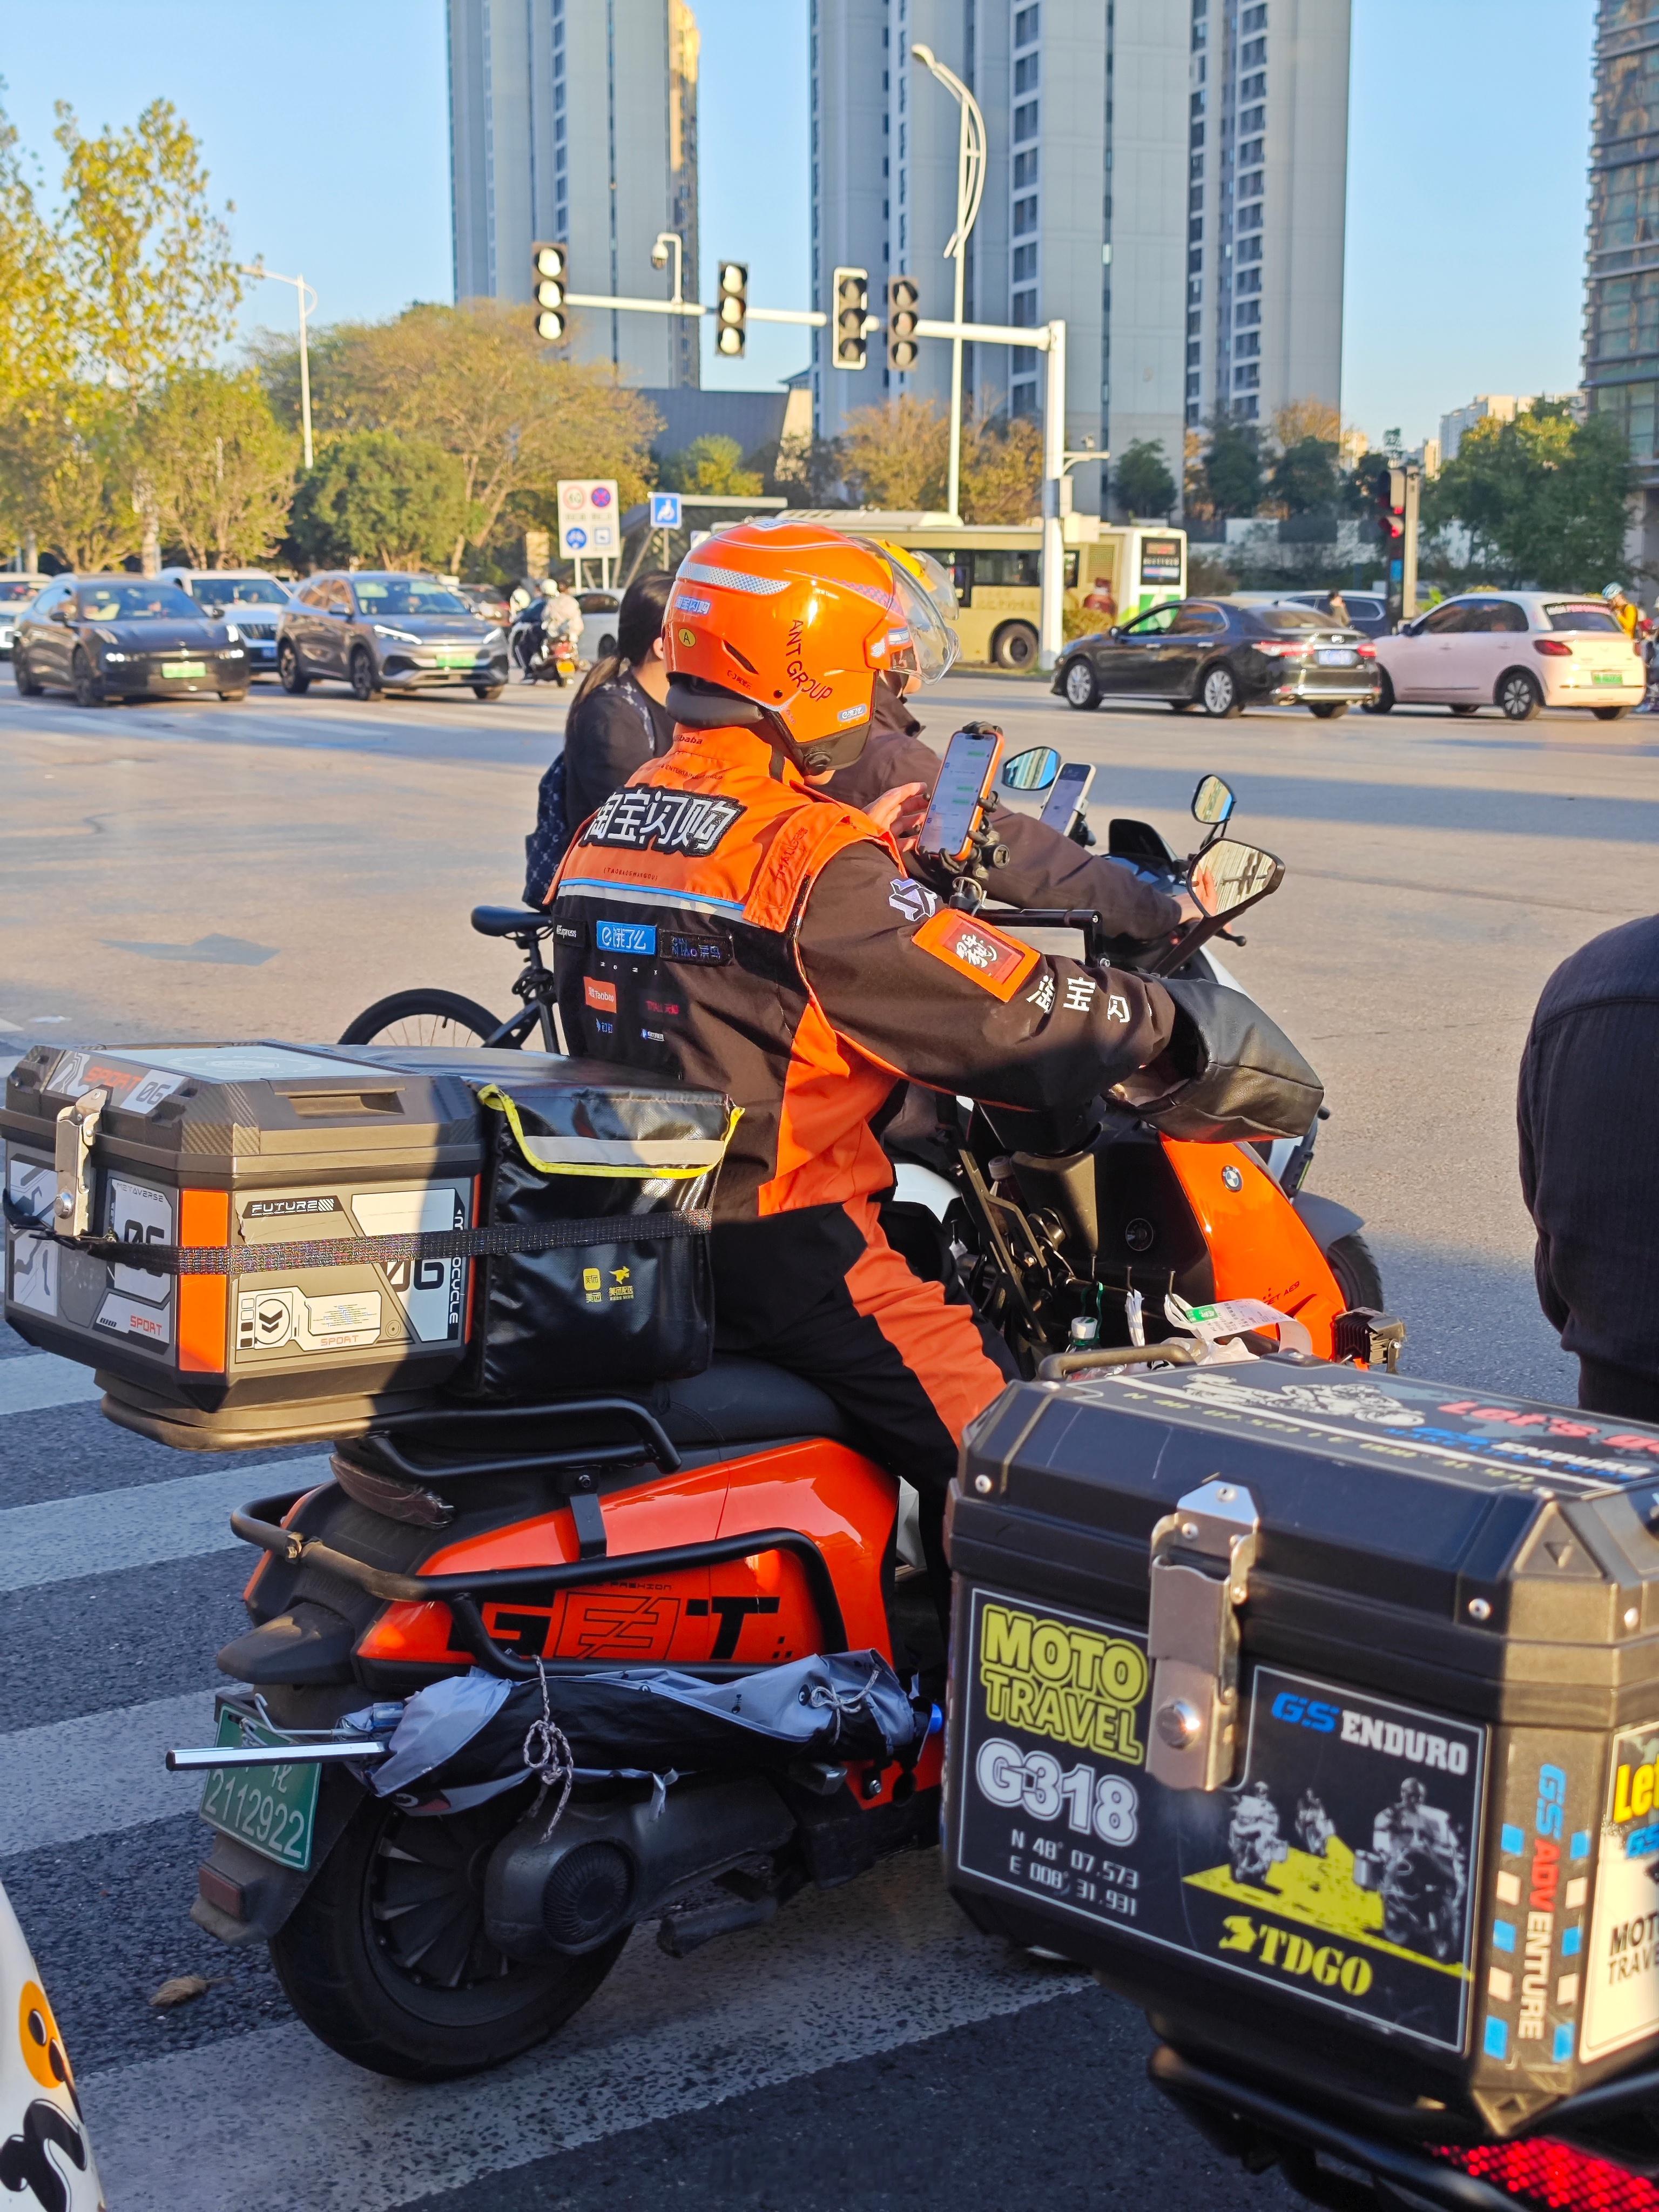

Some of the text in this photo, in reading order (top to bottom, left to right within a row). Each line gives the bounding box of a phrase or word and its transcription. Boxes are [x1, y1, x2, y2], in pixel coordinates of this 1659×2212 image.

[785, 619, 833, 702] ANT GROUP
[583, 787, 738, 849] 淘宝闪购
[117, 1182, 164, 1203] METAVERSE
[251, 1200, 318, 1216] FUTURE
[130, 1313, 162, 1336] SPORT
[320, 1335, 359, 1346] SPORT
[981, 1603, 1149, 1705] MOTO
[981, 1664, 1145, 1765] TRAVEL
[1271, 1691, 1469, 1776] GS ENDURO
[205, 1768, 305, 1859] 2112922
[976, 1737, 1138, 1847] G318
[1535, 1763, 1567, 1841] GS
[1009, 1854, 1021, 1875] E
[1076, 1878, 1138, 1917] 31.931
[1011, 1829, 1024, 1850] N
[1071, 1849, 1139, 1890] 07.573
[1257, 1924, 1373, 1997] TDGO
